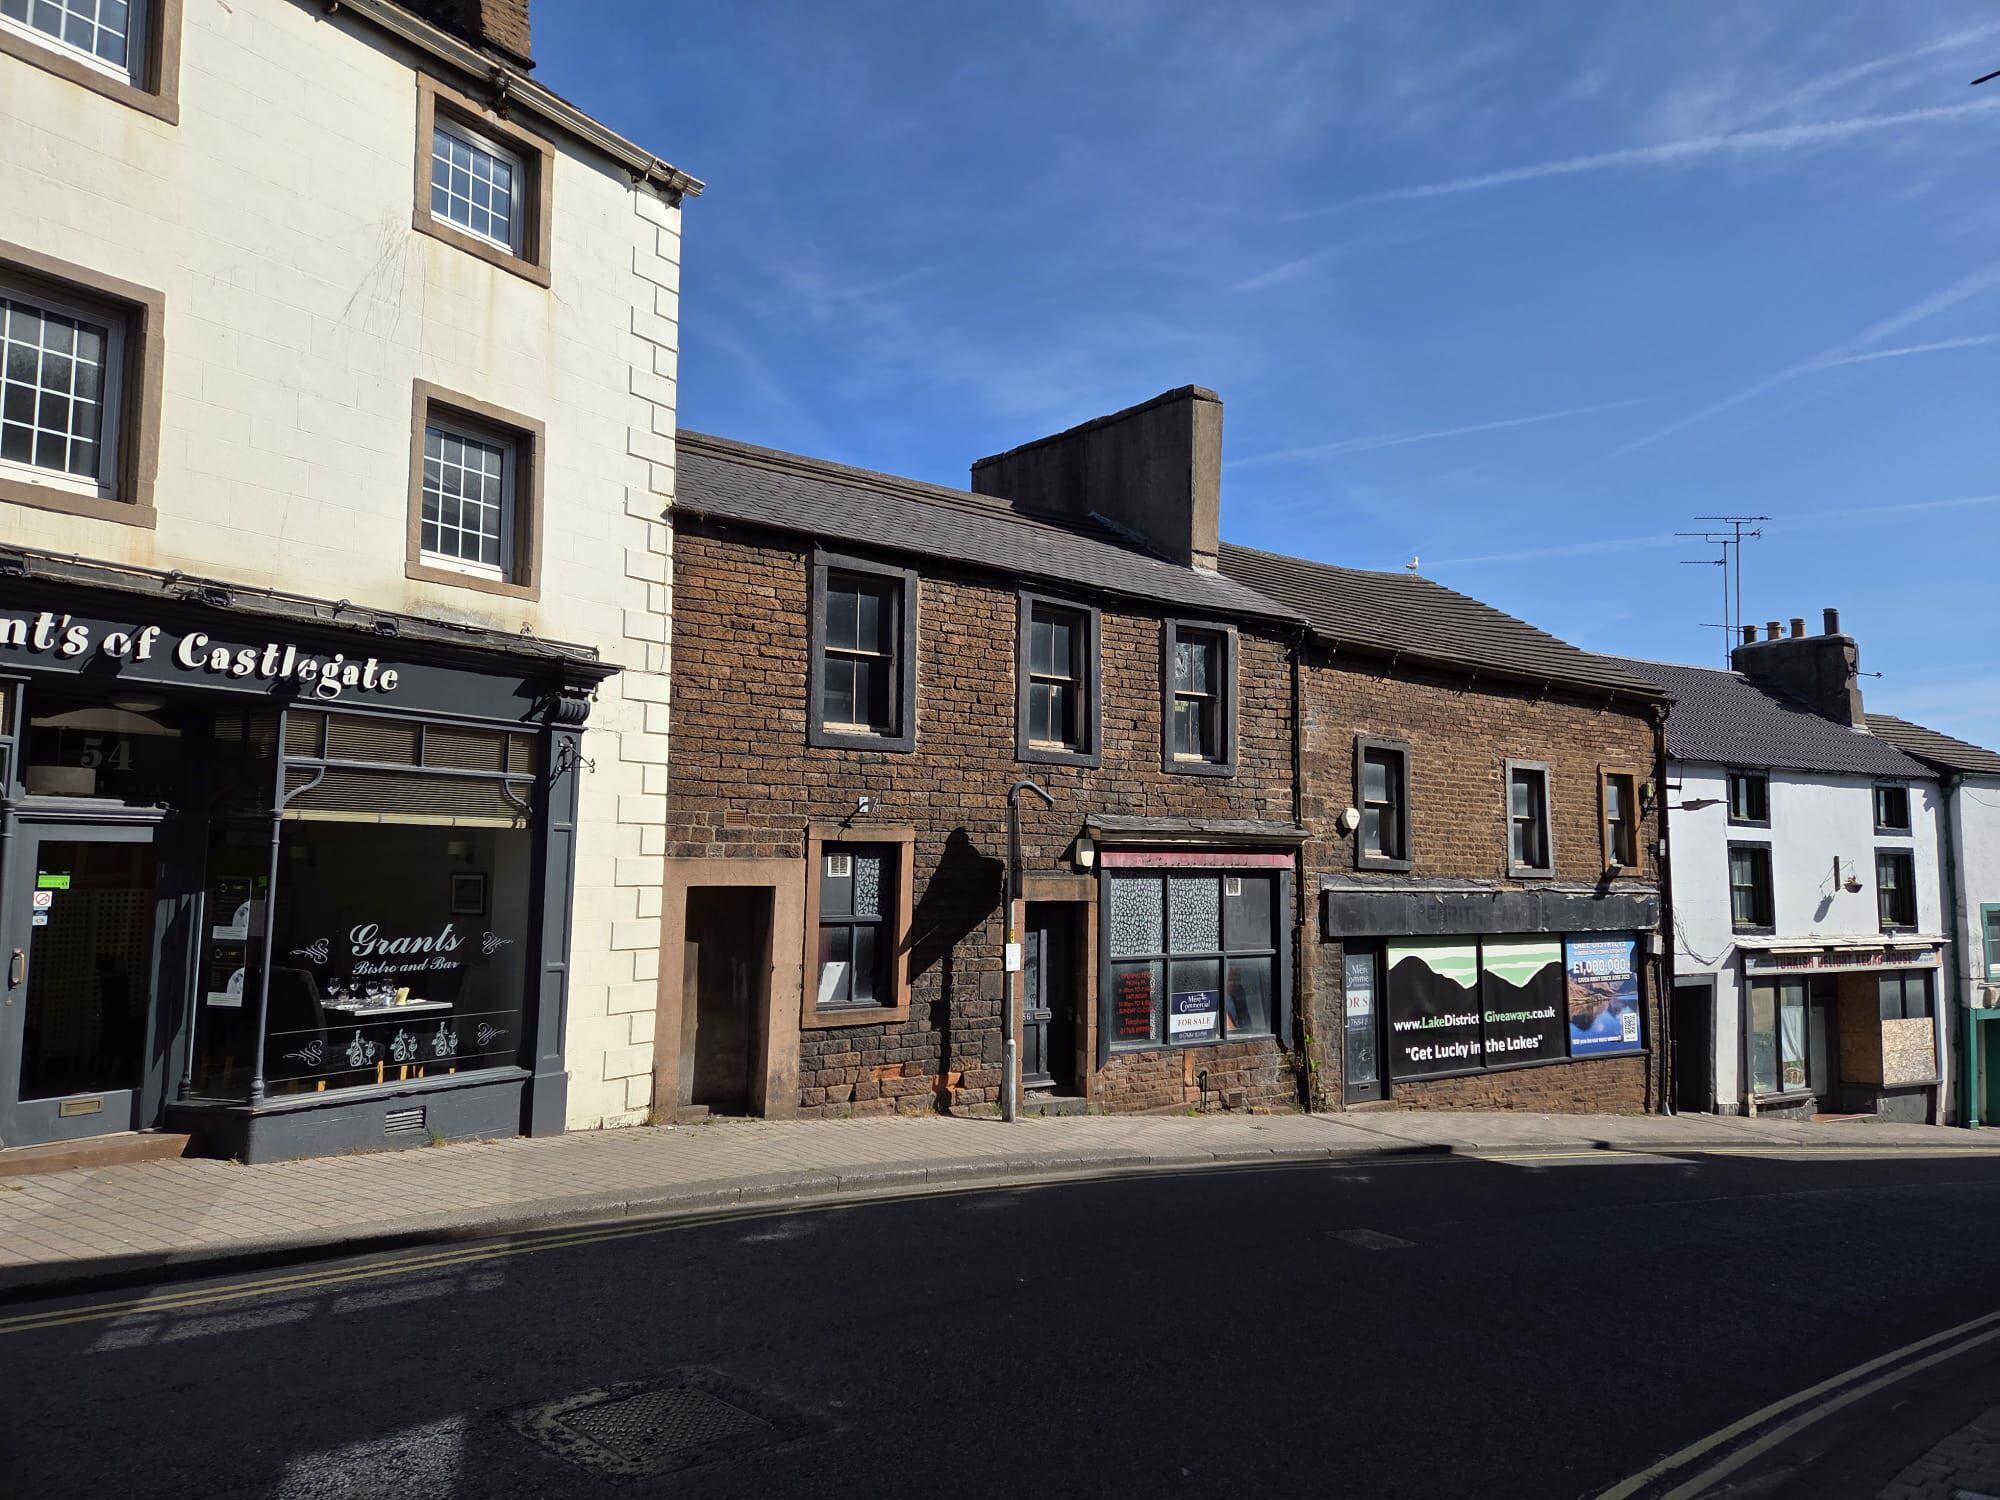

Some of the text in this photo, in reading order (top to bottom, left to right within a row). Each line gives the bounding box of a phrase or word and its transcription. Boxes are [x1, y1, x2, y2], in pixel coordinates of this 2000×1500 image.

[103, 626, 160, 660] of
[178, 632, 398, 699] Castlegate
[80, 737, 134, 772] 54
[350, 923, 466, 956] Grants
[352, 956, 460, 975] Bistro and Bar
[1178, 1016, 1211, 1026] FOR SALE
[1394, 1006, 1556, 1031] www.LakeDistrict Giveaways.co.uk
[1405, 1034, 1543, 1061] "Get Lucky in the Lakes"
